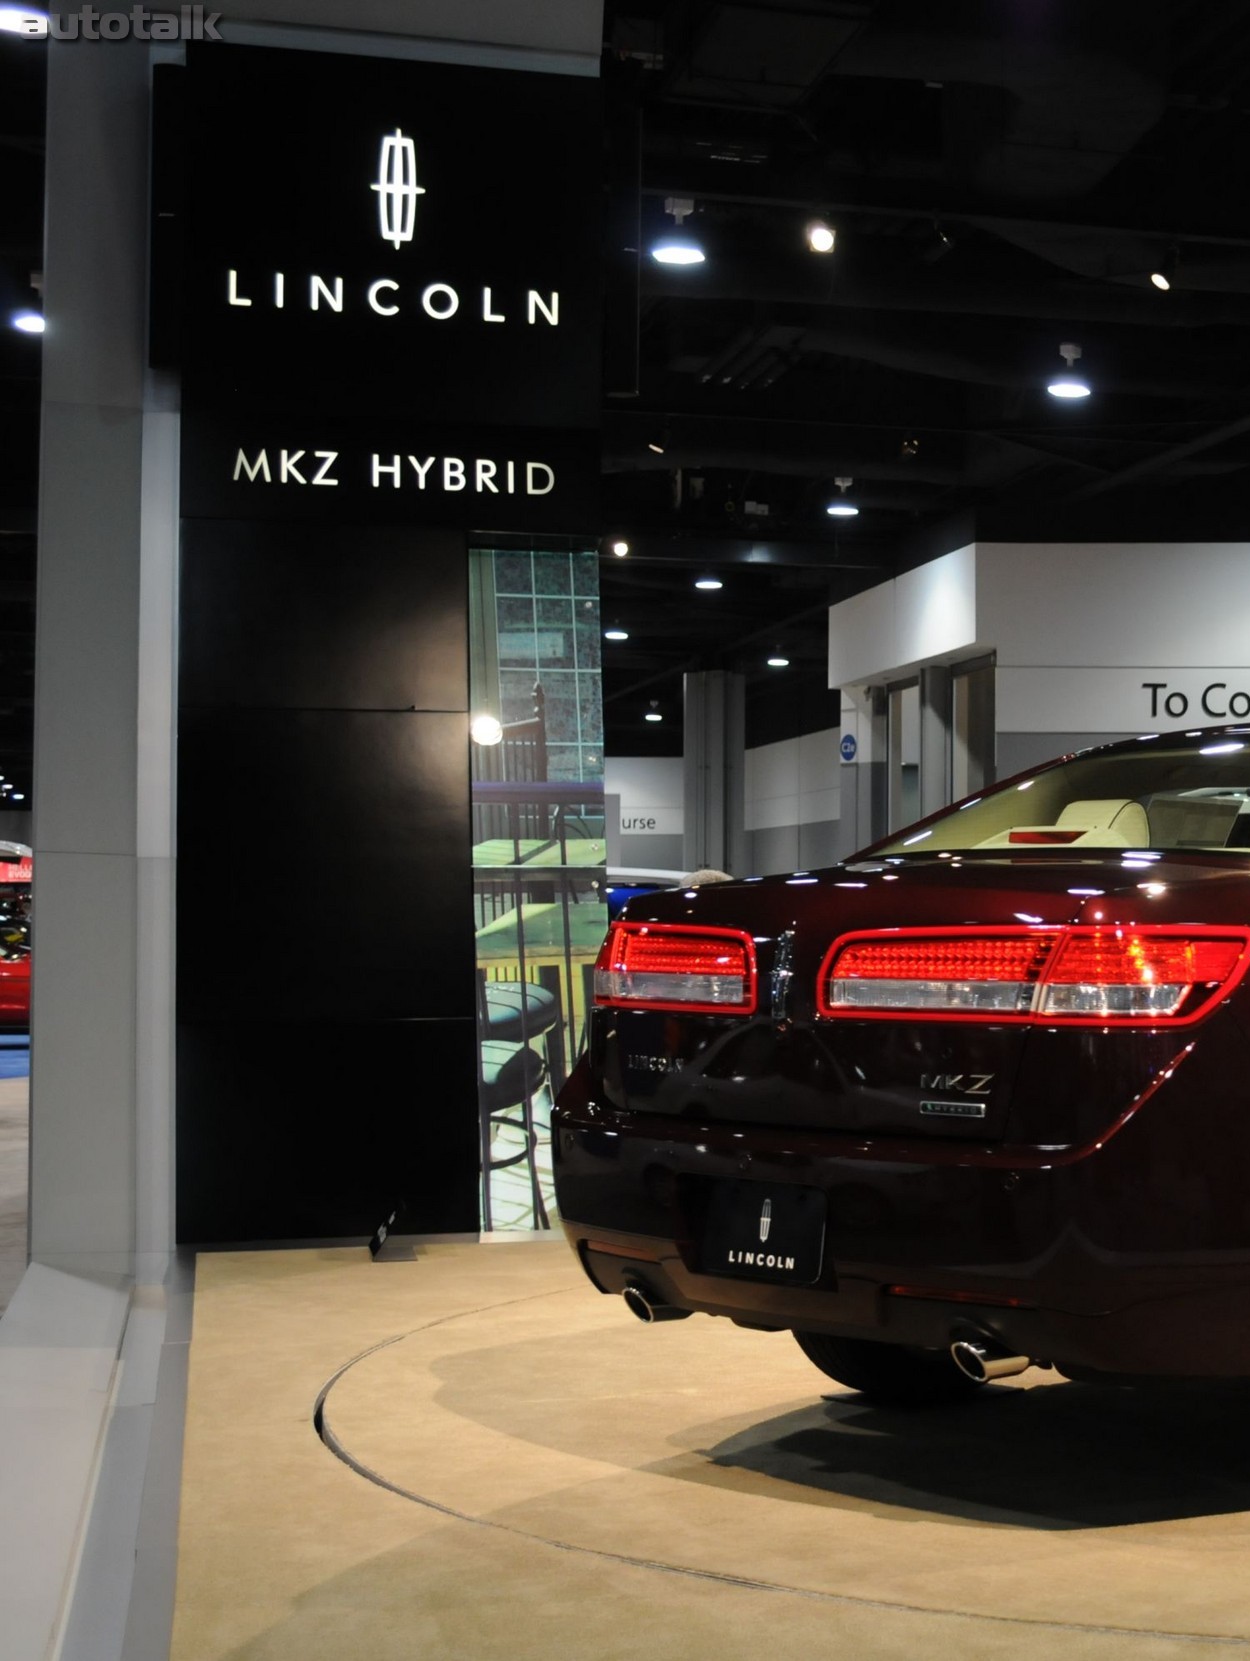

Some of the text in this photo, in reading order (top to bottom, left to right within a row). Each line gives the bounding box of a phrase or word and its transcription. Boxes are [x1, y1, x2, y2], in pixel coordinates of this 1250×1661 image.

[228, 269, 559, 326] LINCOLN
[233, 448, 555, 495] MKZ HYBRID
[1142, 683, 1188, 718] To
[920, 1072, 996, 1095] MKZ
[728, 1250, 795, 1270] LINCOLN
